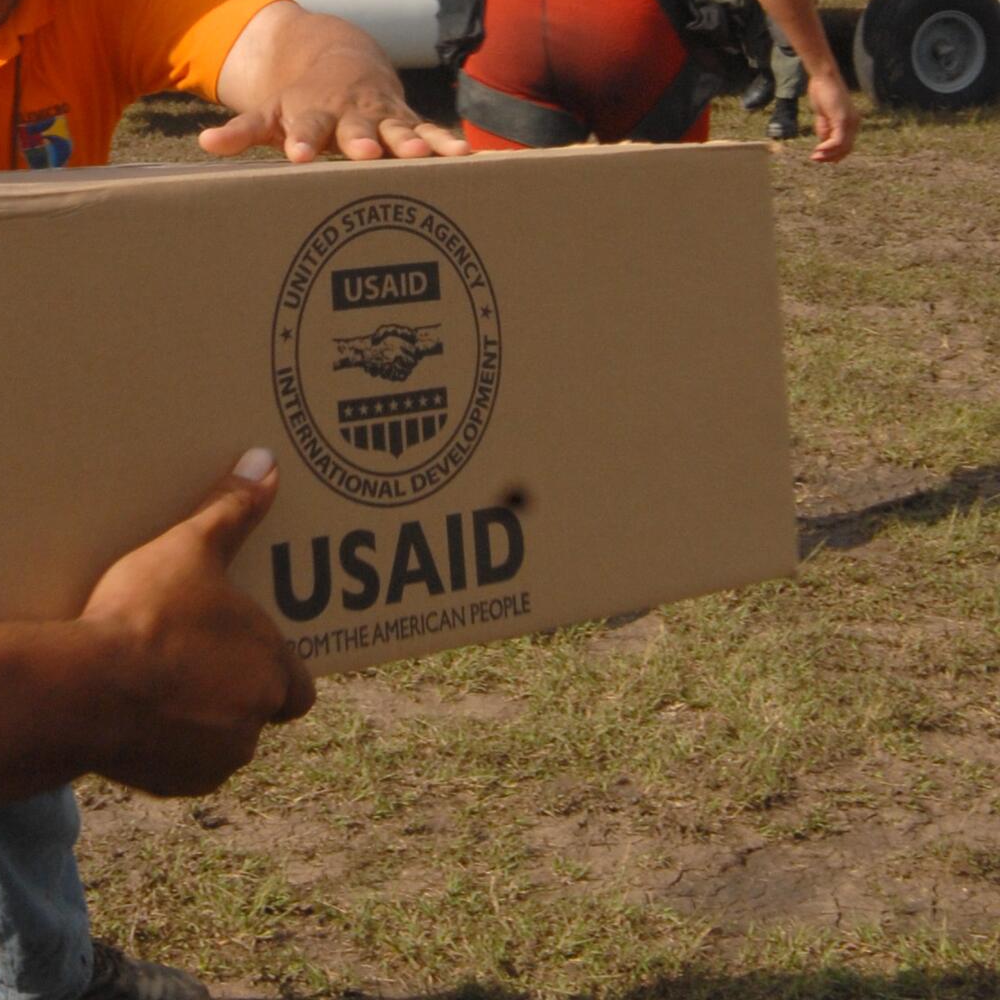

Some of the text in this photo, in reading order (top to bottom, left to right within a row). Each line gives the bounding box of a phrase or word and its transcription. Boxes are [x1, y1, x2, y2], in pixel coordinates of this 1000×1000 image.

[283, 203, 486, 310] UNITED STATES AGENCY
[343, 271, 428, 303] USAID
[276, 335, 498, 500] INTERNATIONAL DEVELOPMENT
[271, 505, 525, 622] USAID
[285, 592, 532, 660] ROM THE AMERICAN PEOPLE
